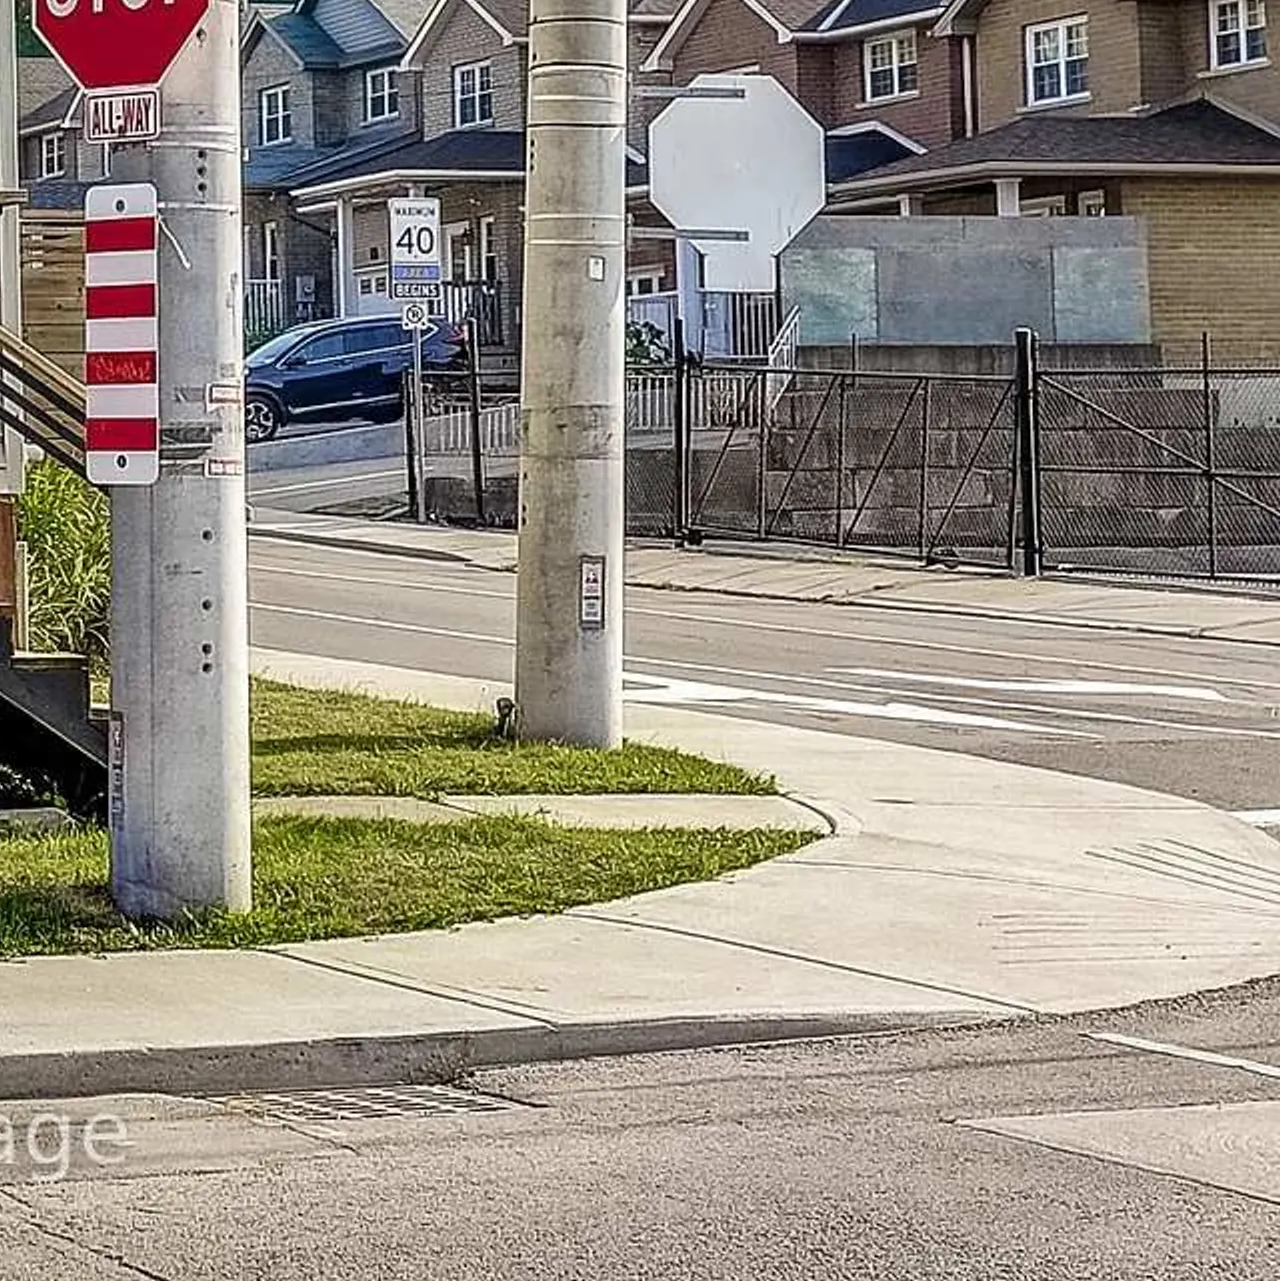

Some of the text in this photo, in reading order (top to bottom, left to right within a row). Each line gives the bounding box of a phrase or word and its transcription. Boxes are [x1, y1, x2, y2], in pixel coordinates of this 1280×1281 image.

[92, 97, 152, 136] ALL-WAY
[395, 226, 434, 255] 40
[396, 284, 438, 297] BEGINS
